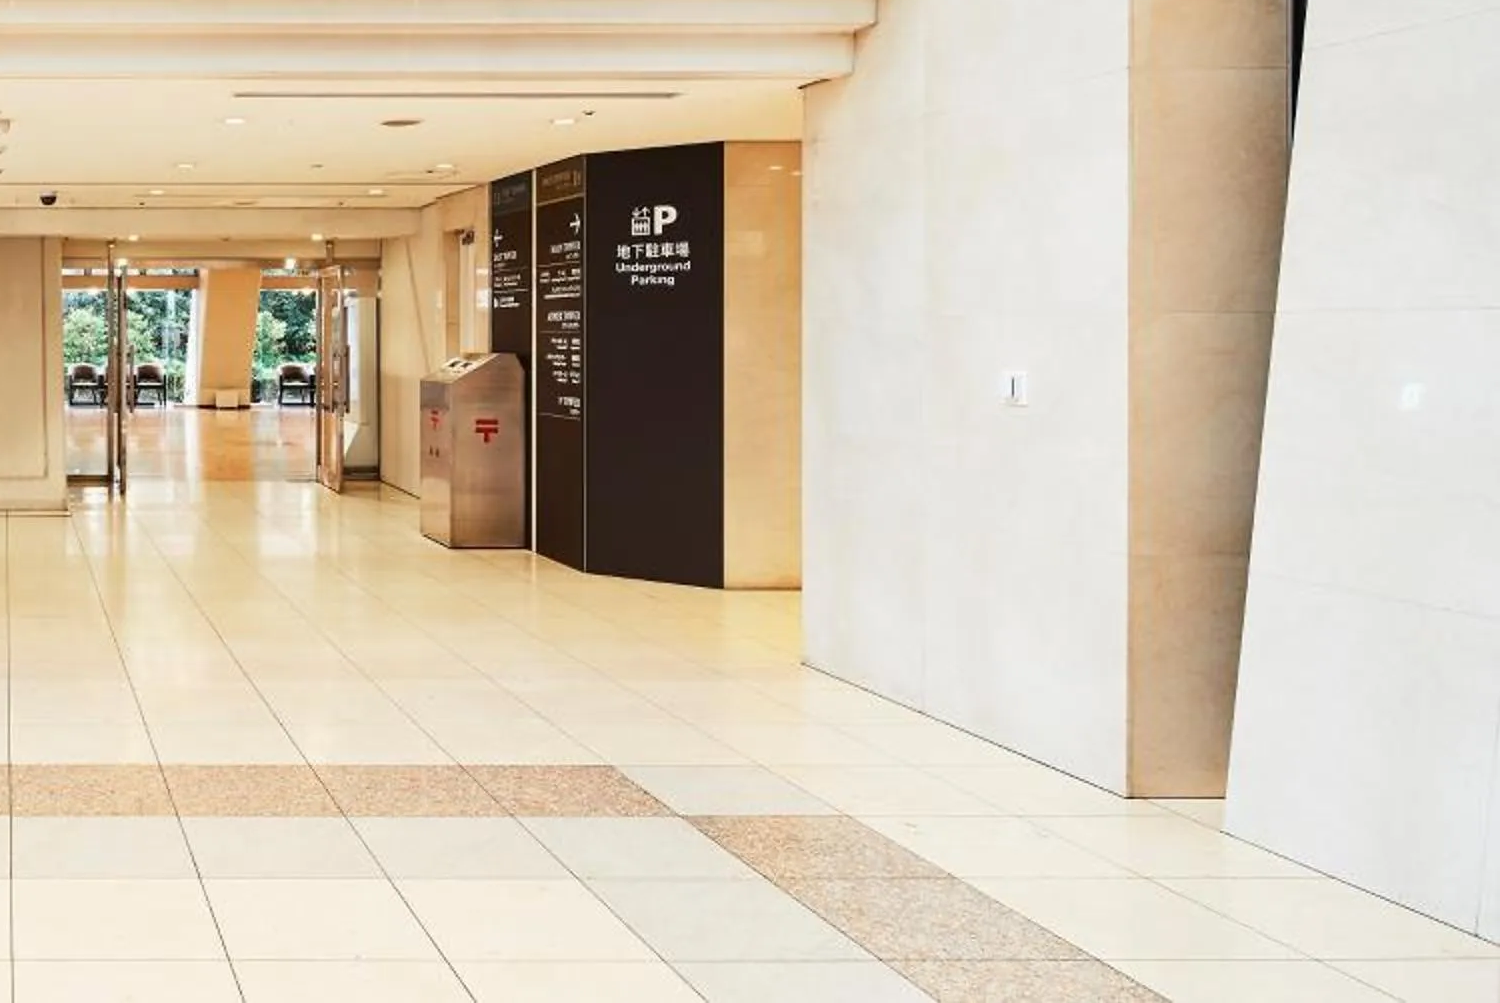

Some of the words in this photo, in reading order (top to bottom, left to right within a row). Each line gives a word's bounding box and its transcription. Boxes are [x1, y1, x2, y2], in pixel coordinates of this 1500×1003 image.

[653, 205, 678, 236] P
[616, 241, 690, 260] 地下駐車場
[615, 260, 691, 274] Underground
[631, 274, 675, 286] Parking
